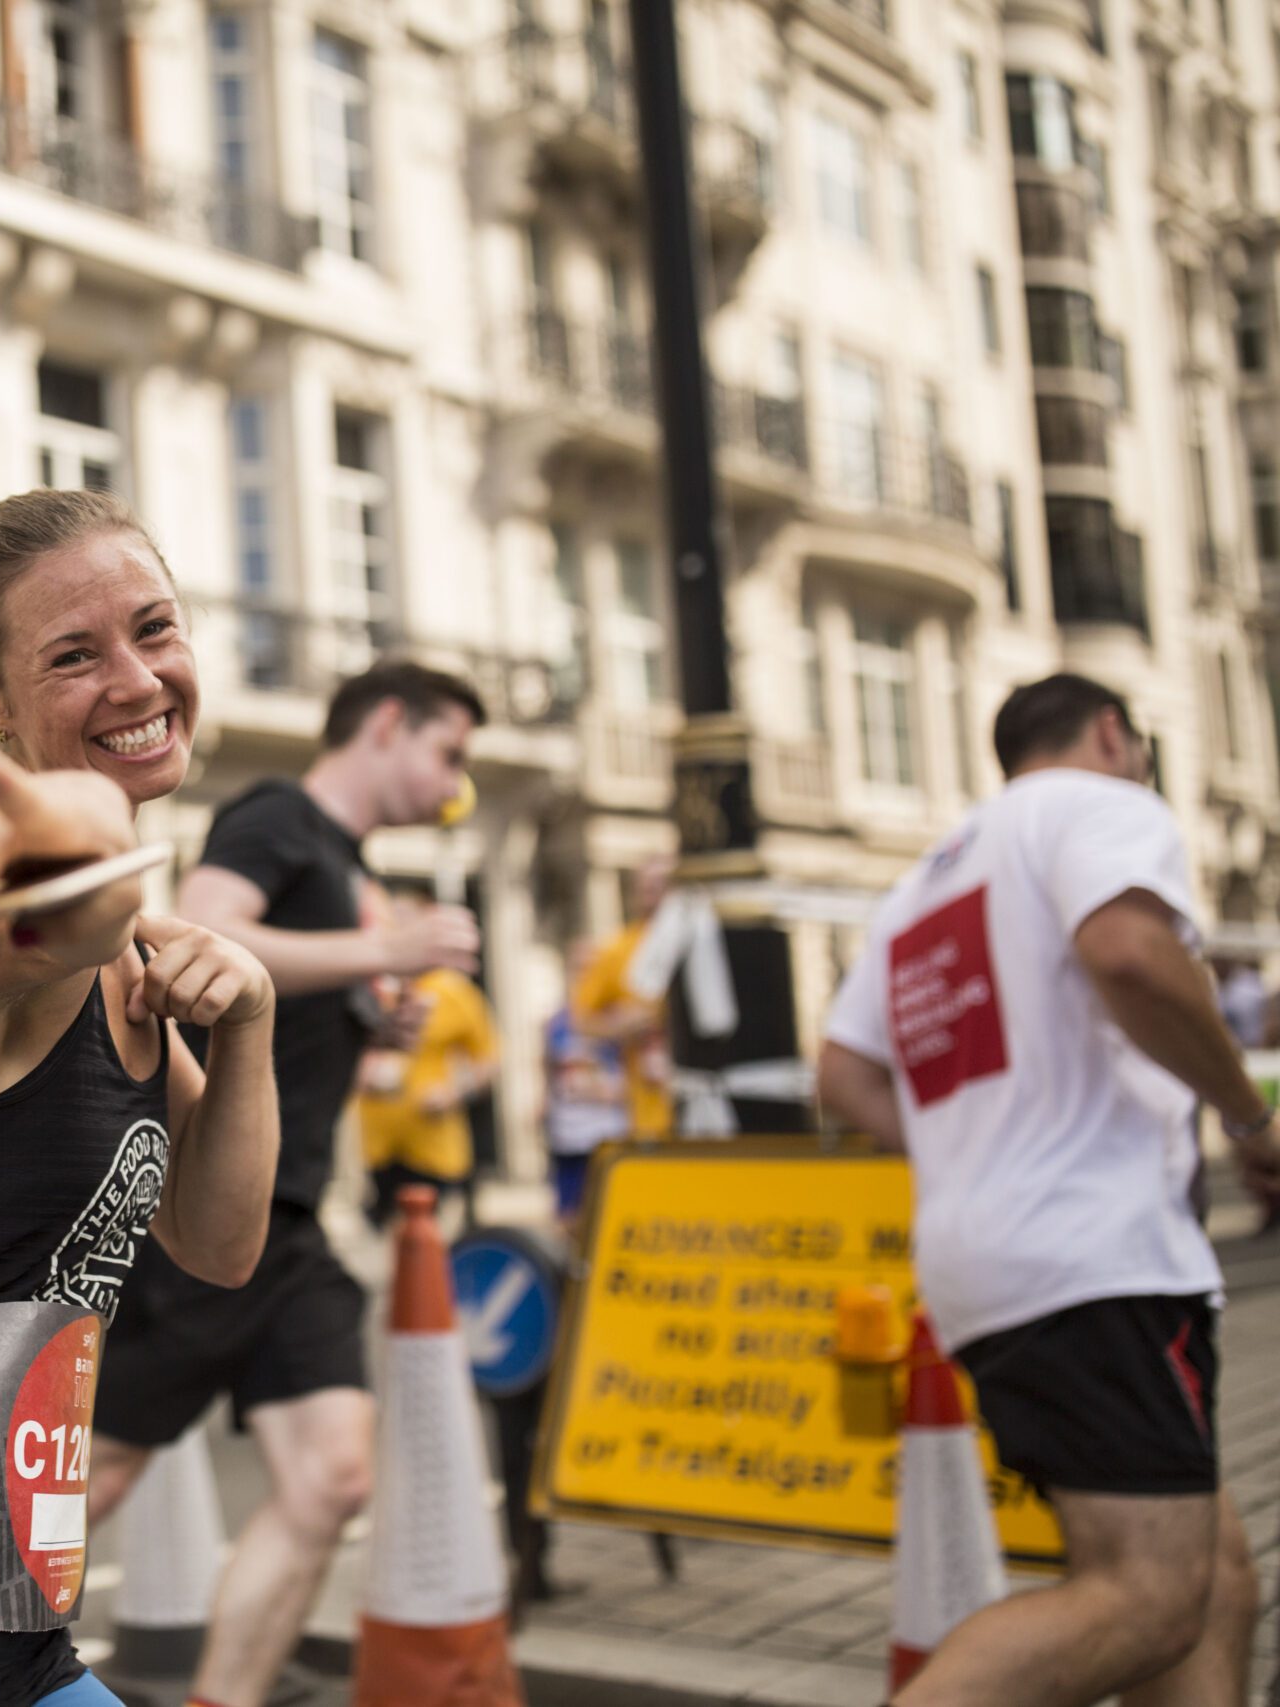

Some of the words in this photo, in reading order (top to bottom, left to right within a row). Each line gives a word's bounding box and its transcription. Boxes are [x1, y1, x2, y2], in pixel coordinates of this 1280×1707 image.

[74, 1184, 122, 1244] THE
[120, 1132, 150, 1186] FOOD
[617, 1219, 840, 1258] ADVANCED
[605, 1263, 718, 1309] Road
[660, 1322, 712, 1355] no
[593, 1363, 812, 1428] Piccadilly
[576, 1435, 620, 1463] or
[638, 1429, 857, 1496] Trafalgar
